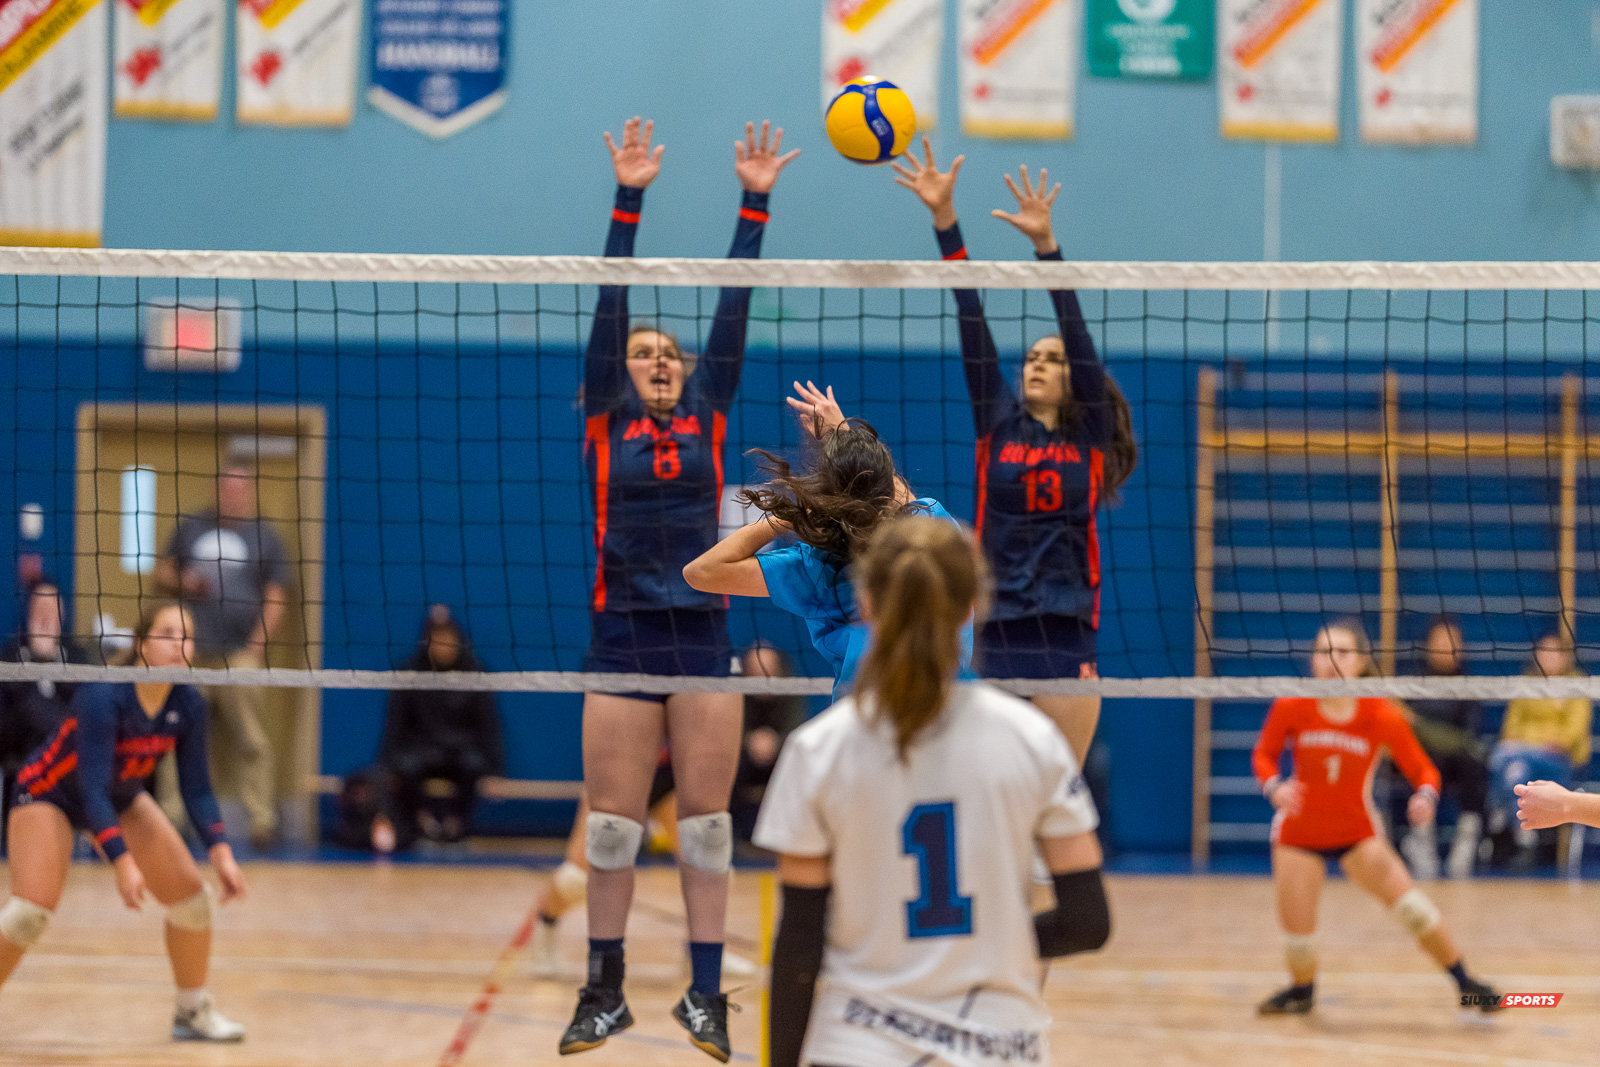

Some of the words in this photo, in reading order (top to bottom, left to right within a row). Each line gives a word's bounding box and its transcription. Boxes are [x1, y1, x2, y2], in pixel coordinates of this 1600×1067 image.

[653, 440, 681, 479] 8
[1022, 469, 1062, 511] 13
[1325, 754, 1342, 785] 1
[903, 802, 972, 938] 1
